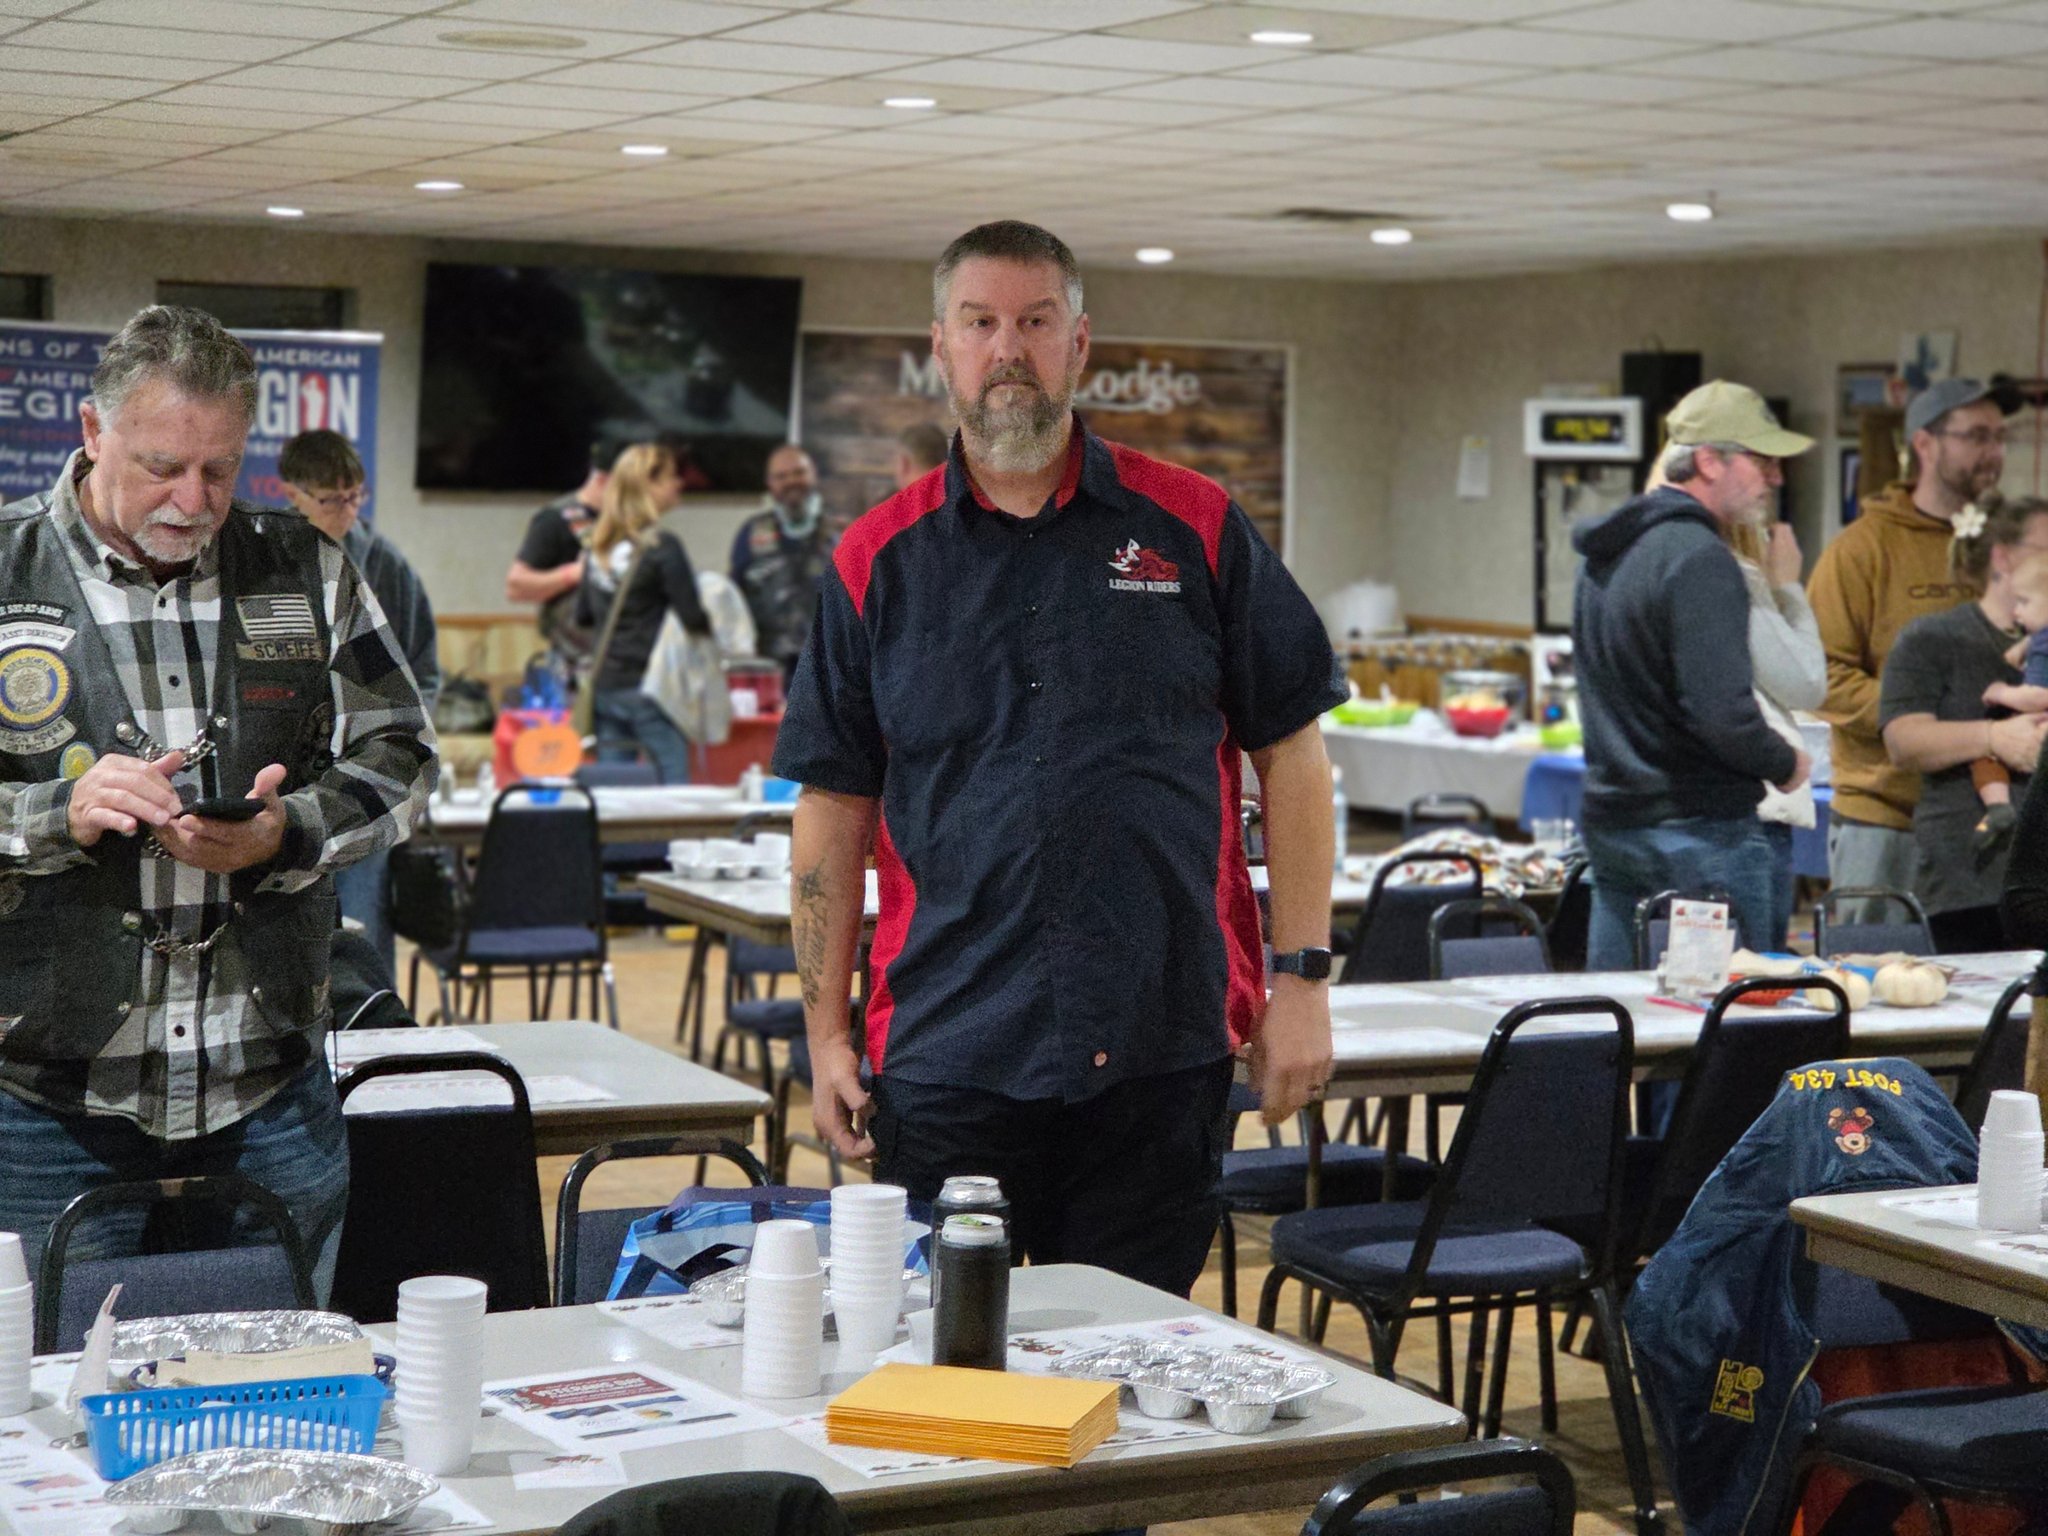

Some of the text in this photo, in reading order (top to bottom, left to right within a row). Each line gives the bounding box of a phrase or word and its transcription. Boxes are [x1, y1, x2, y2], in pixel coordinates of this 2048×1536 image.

[0, 338, 33, 358] NS
[44, 340, 81, 360] OF
[252, 346, 362, 367] AMERICAN
[1076, 357, 1200, 415] odge
[0, 387, 74, 421] EGI
[250, 475, 284, 498] YO
[1108, 578, 1182, 594] LEGION RIDERS
[1788, 1068, 1903, 1096] POST 434
